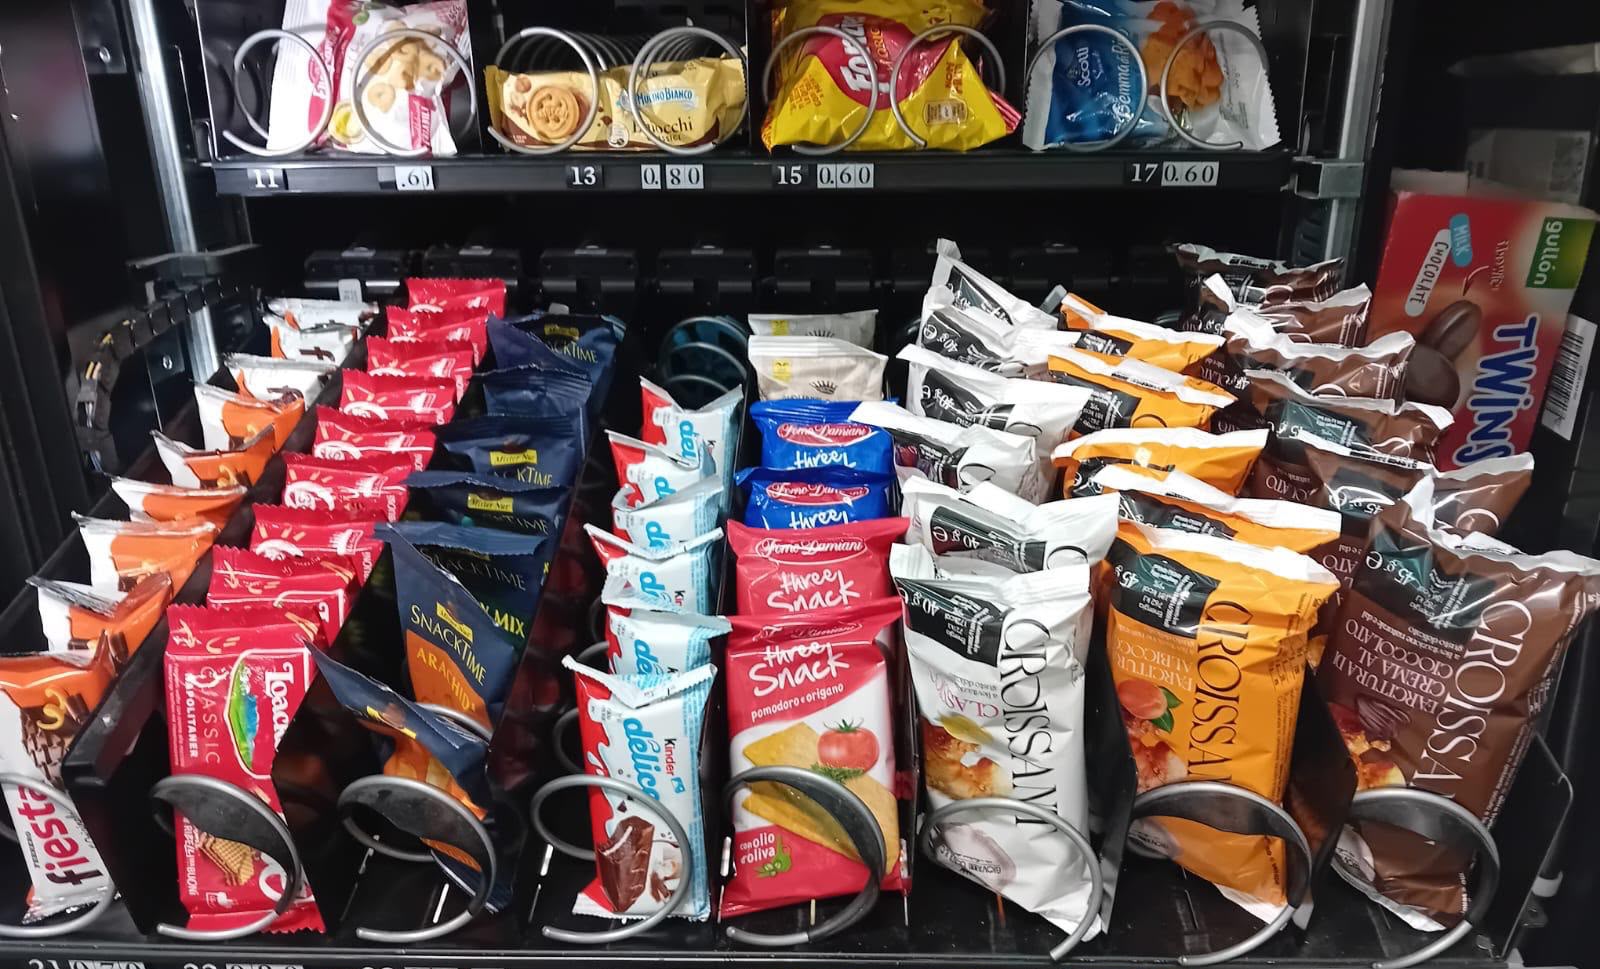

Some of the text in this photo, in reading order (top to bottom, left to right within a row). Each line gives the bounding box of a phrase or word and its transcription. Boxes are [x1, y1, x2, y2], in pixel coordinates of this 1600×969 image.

[254, 169, 279, 188] 11
[571, 166, 597, 185] 13
[777, 165, 802, 185] 15
[819, 166, 872, 185] 0.60
[1131, 163, 1159, 183] 17
[1164, 163, 1216, 183] 0.60
[1453, 224, 1472, 257] MILK
[1409, 240, 1449, 305] CHOCOLATE
[794, 450, 843, 469] three
[963, 536, 981, 550] 40
[780, 569, 836, 595] three
[1394, 567, 1415, 586] 45
[767, 571, 861, 613] Snack
[922, 601, 941, 617] 40
[494, 609, 526, 640] MIX
[410, 604, 488, 687] SNACKTIME
[763, 641, 828, 668] three
[1344, 618, 1455, 680] CIOCCOLATO
[749, 643, 851, 698] Snack
[1356, 646, 1448, 698] CREMA AL
[750, 697, 800, 722] pomodoro
[805, 682, 844, 704] origano
[1186, 600, 1254, 781] CROISSA
[1345, 661, 1440, 715] FARCITURA
[1410, 599, 1533, 781] CROISSA
[18, 784, 103, 886] fiesta
[752, 832, 775, 849] olio
